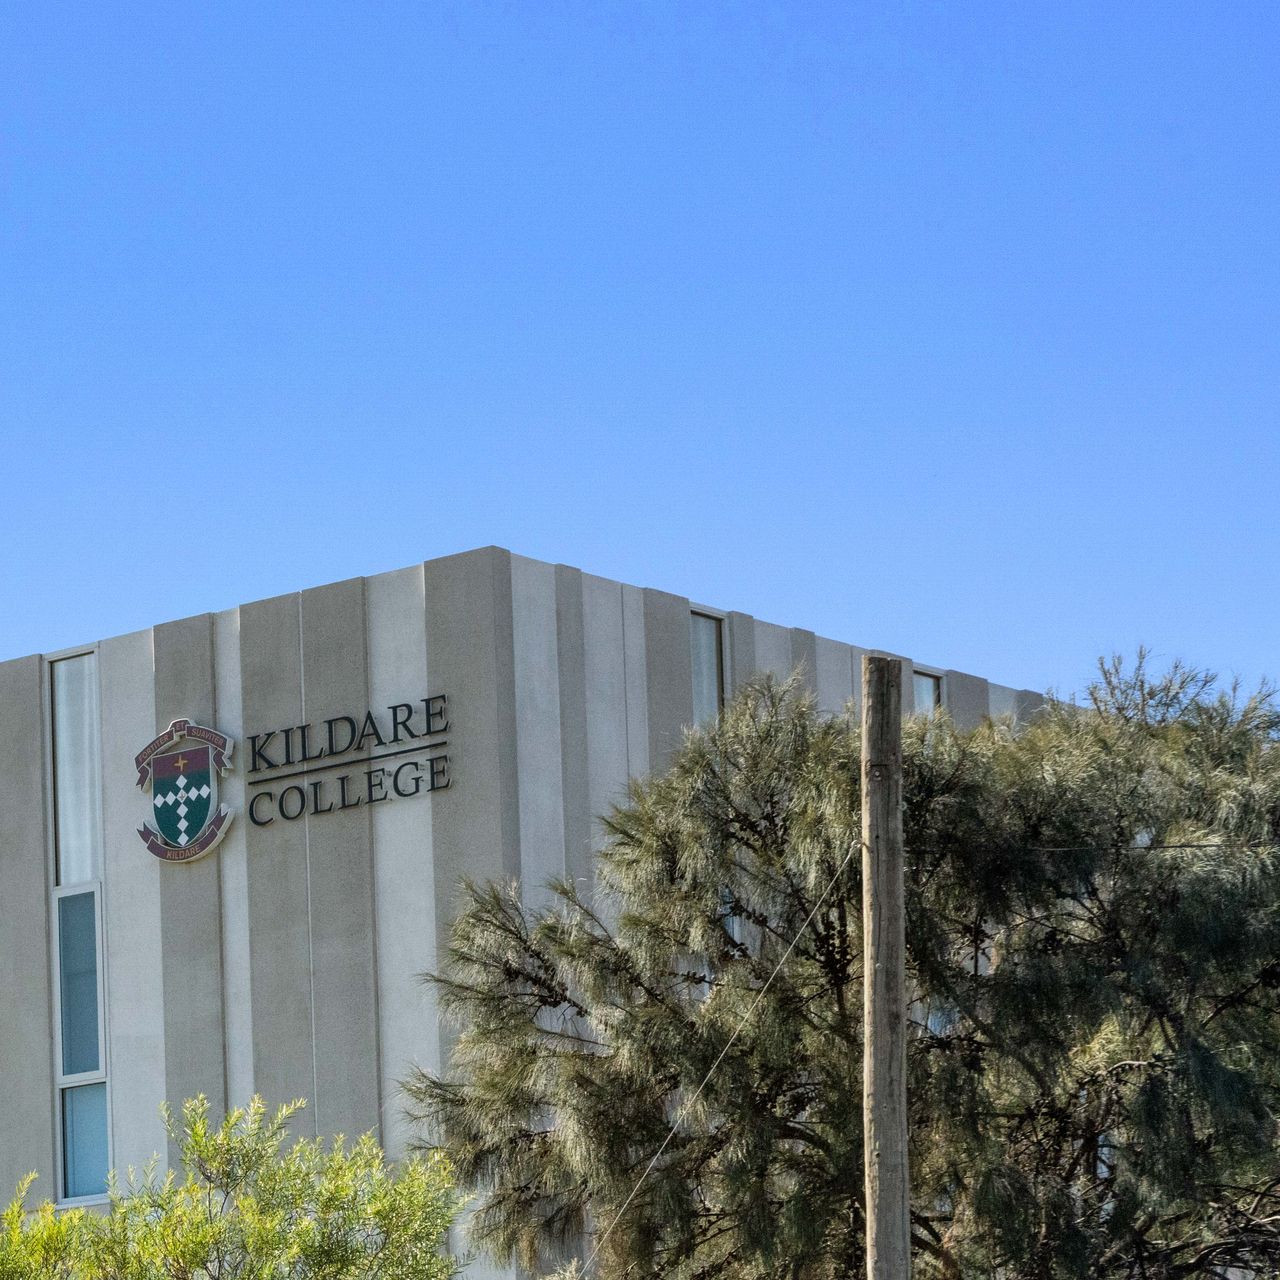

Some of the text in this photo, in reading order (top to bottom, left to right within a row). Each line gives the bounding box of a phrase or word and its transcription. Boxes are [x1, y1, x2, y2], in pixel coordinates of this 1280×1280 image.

[139, 723, 224, 762] FORTITER ET SUAVITER
[246, 693, 451, 773] KILDARE
[248, 754, 452, 827] COLLEGE
[166, 846, 200, 860] KILDARE
